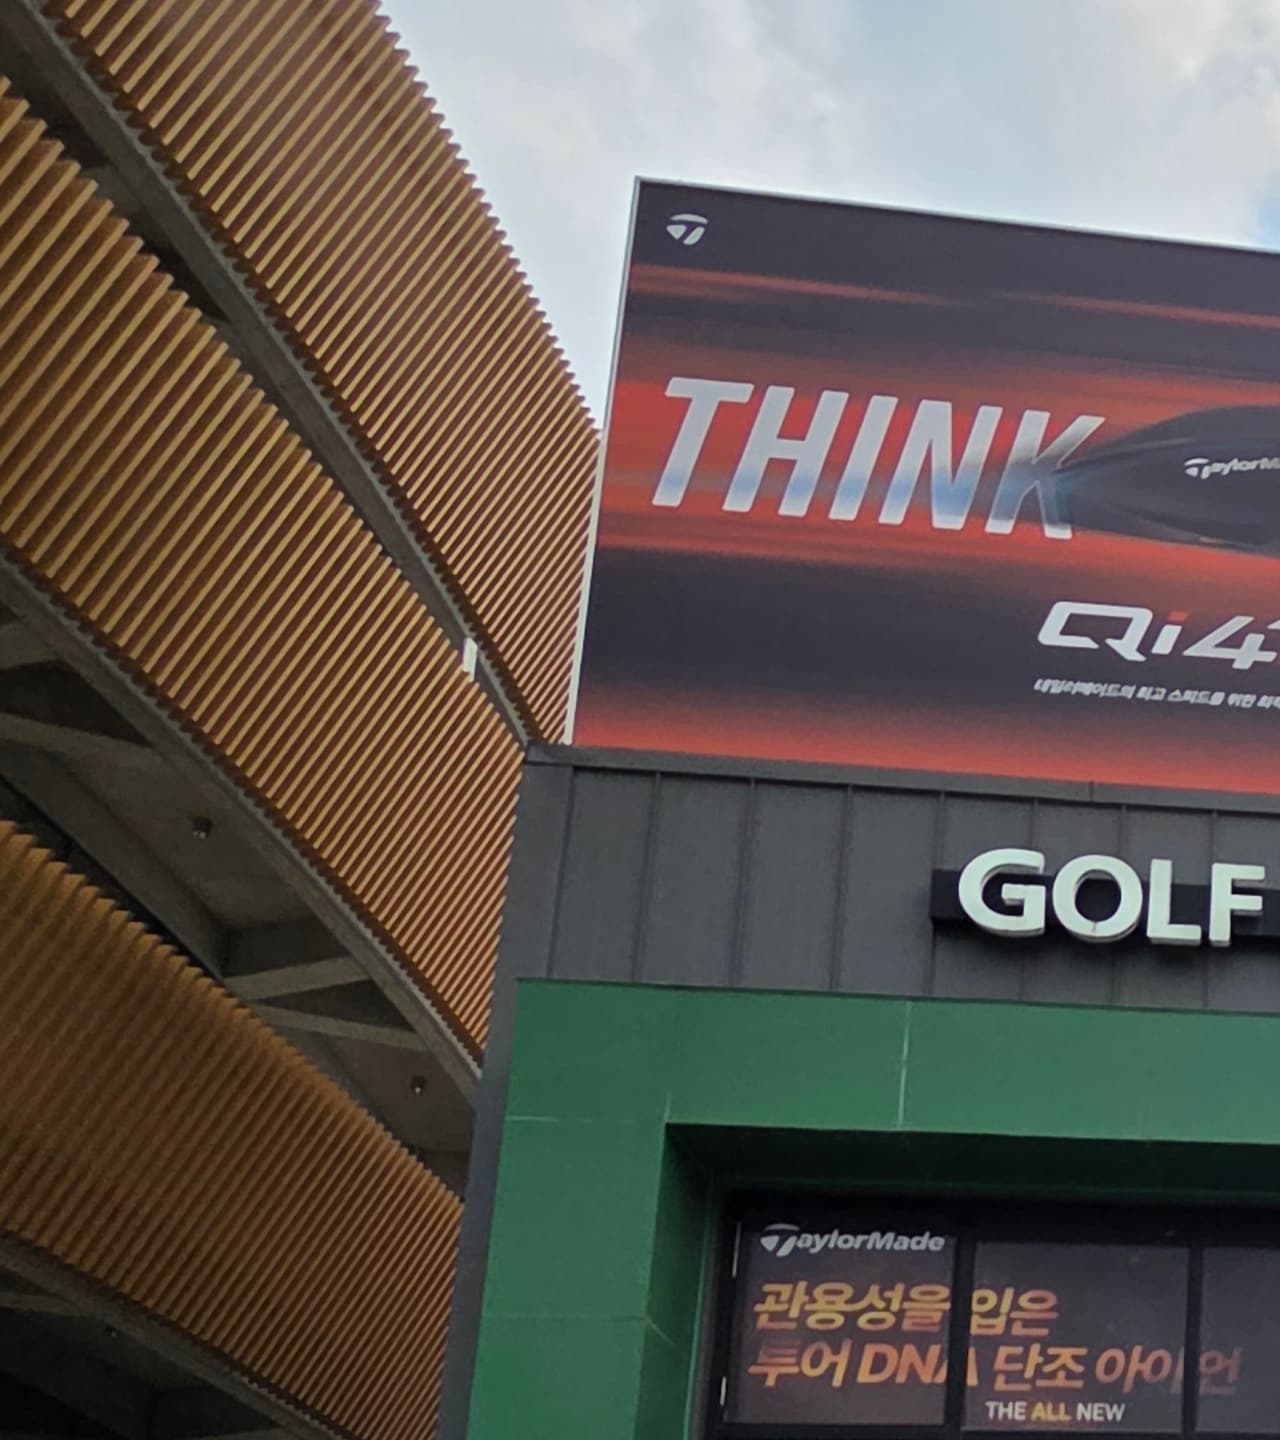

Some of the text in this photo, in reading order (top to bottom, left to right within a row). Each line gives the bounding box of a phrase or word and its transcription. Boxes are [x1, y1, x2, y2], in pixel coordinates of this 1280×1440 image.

[652, 376, 1105, 540] THINK
[957, 847, 1266, 948] GOLF
[760, 1223, 946, 1257] TaylorMade
[753, 1280, 1060, 1337] 관용성을 입은
[993, 1342, 1089, 1393] 단조
[1094, 1343, 1244, 1397] 아이언
[985, 1401, 1126, 1424] THE ALL NEW
